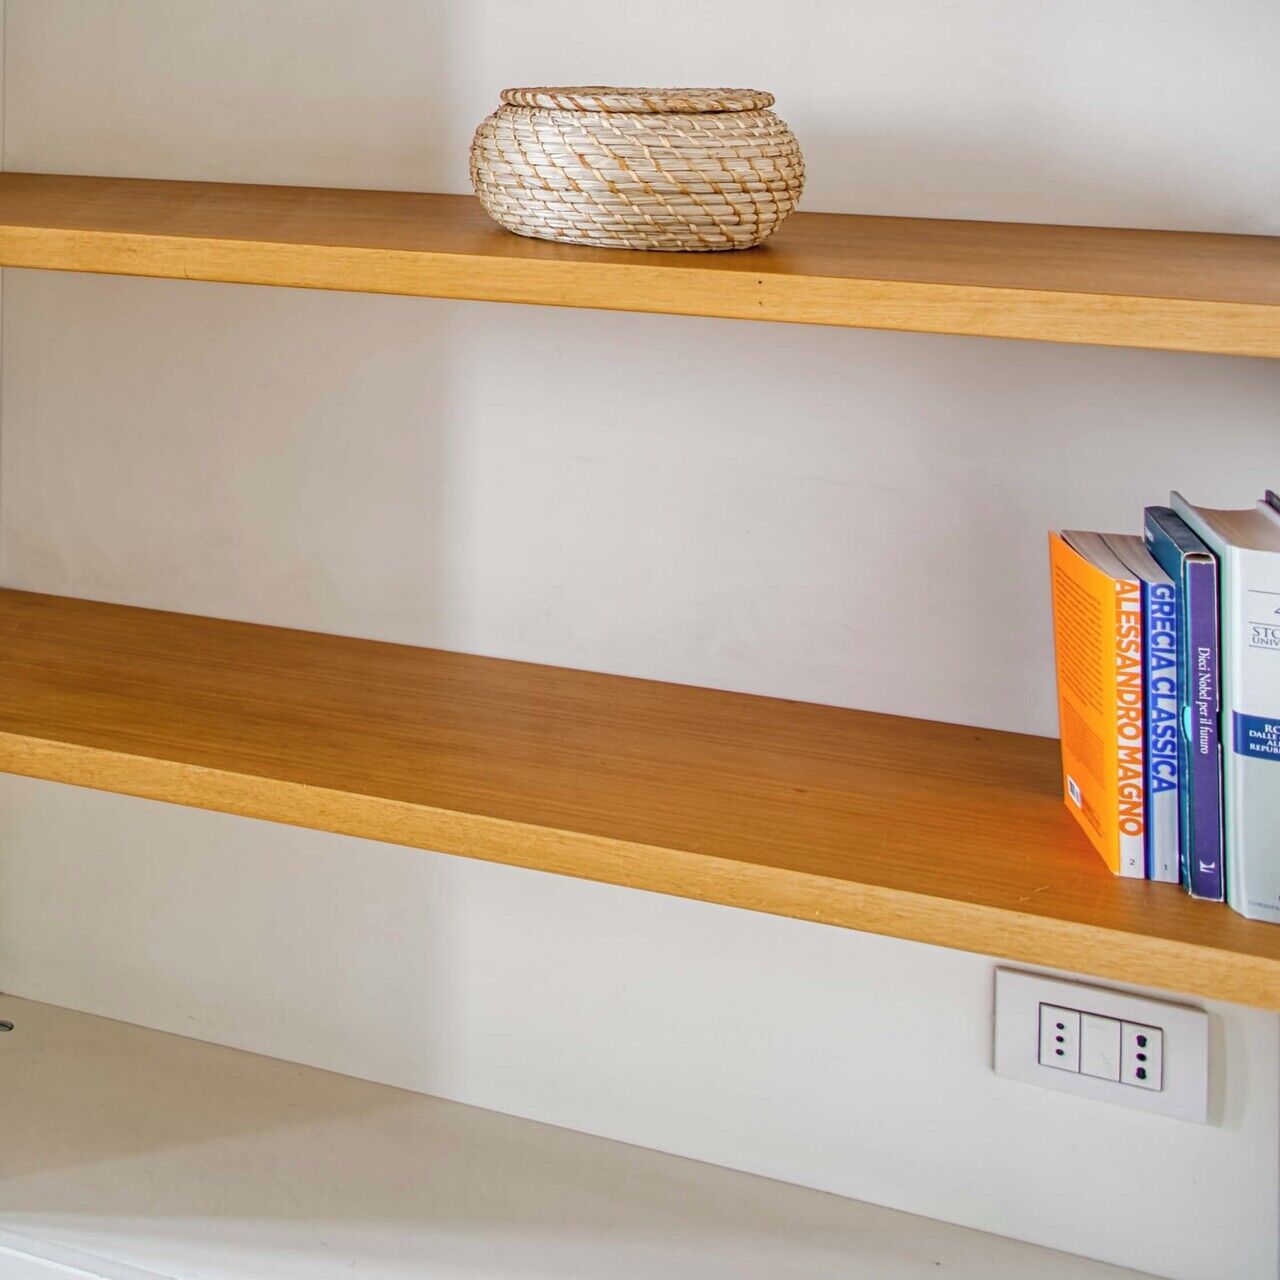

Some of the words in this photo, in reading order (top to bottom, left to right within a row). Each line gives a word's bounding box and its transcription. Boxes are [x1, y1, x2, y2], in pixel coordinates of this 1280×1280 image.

[1150, 583, 1176, 669] GRECIA
[1114, 579, 1142, 742] ALESSANDRO
[1198, 647, 1211, 671] Dieci
[1198, 672, 1212, 700] Nobel
[1195, 700, 1208, 716] per
[1151, 676, 1177, 793] CLASSICA
[1200, 726, 1213, 754] futuro
[1249, 729, 1278, 740] DALLE
[1117, 742, 1145, 837] MAGNO
[1128, 858, 1136, 866] 2
